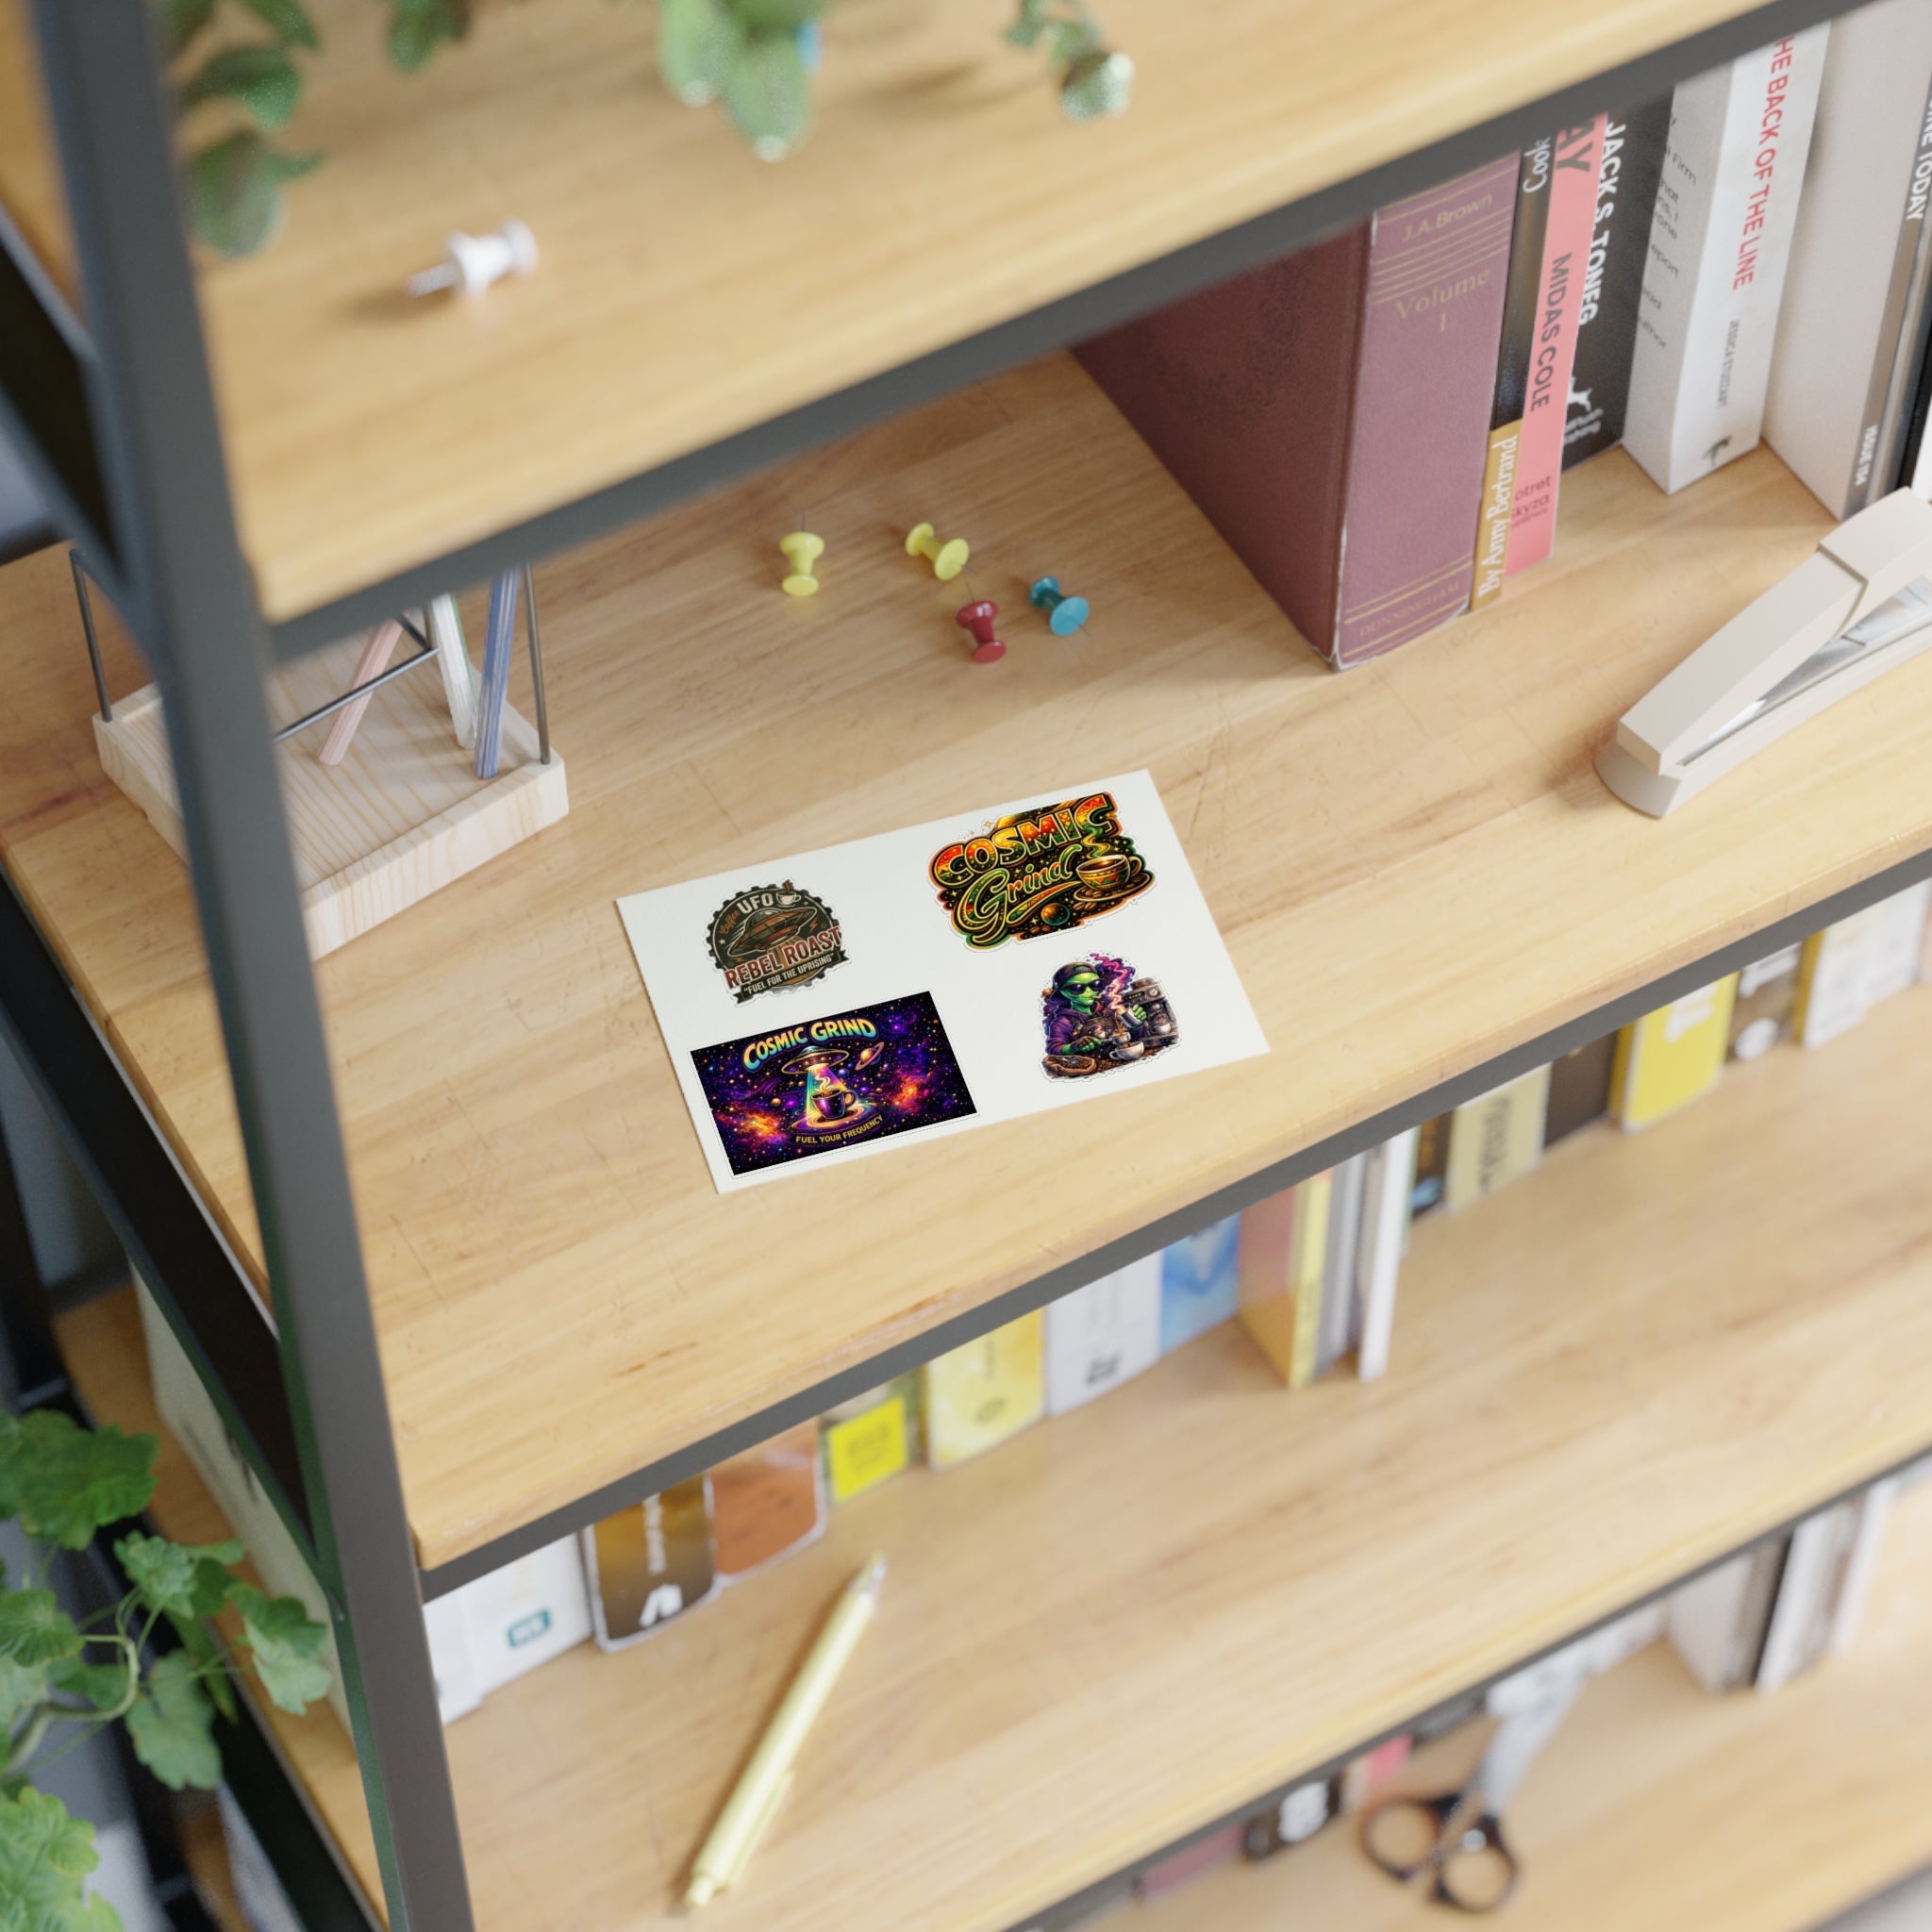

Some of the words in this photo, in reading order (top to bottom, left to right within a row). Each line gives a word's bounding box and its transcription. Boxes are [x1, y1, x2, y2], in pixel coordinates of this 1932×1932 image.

[1758, 74, 1789, 145] BACK
[1597, 122, 1626, 199] JACK
[1754, 148, 1776, 180] OF
[1742, 183, 1771, 236] THE
[1733, 235, 1760, 291] LINE
[1395, 269, 1491, 320] Volume
[1541, 252, 1573, 343] MIDAS
[1530, 345, 1557, 413] COLE
[1486, 433, 1519, 520] Bertrand
[1477, 568, 1505, 598] By
[933, 793, 1115, 886] COSMIC
[719, 909, 741, 935] Coffee
[736, 892, 774, 914] UFO
[957, 844, 1083, 944] Grind
[724, 952, 784, 990] REBEL
[782, 925, 842, 966] ROAST
[767, 975, 782, 989] FOR
[781, 968, 798, 981] THE
[743, 1027, 808, 1070] COSMIC
[810, 1018, 877, 1041] GRIND
[795, 1136, 818, 1144] FUEL
[819, 1133, 842, 1143] YOUR
[842, 1115, 884, 1139] FREQUENCY
